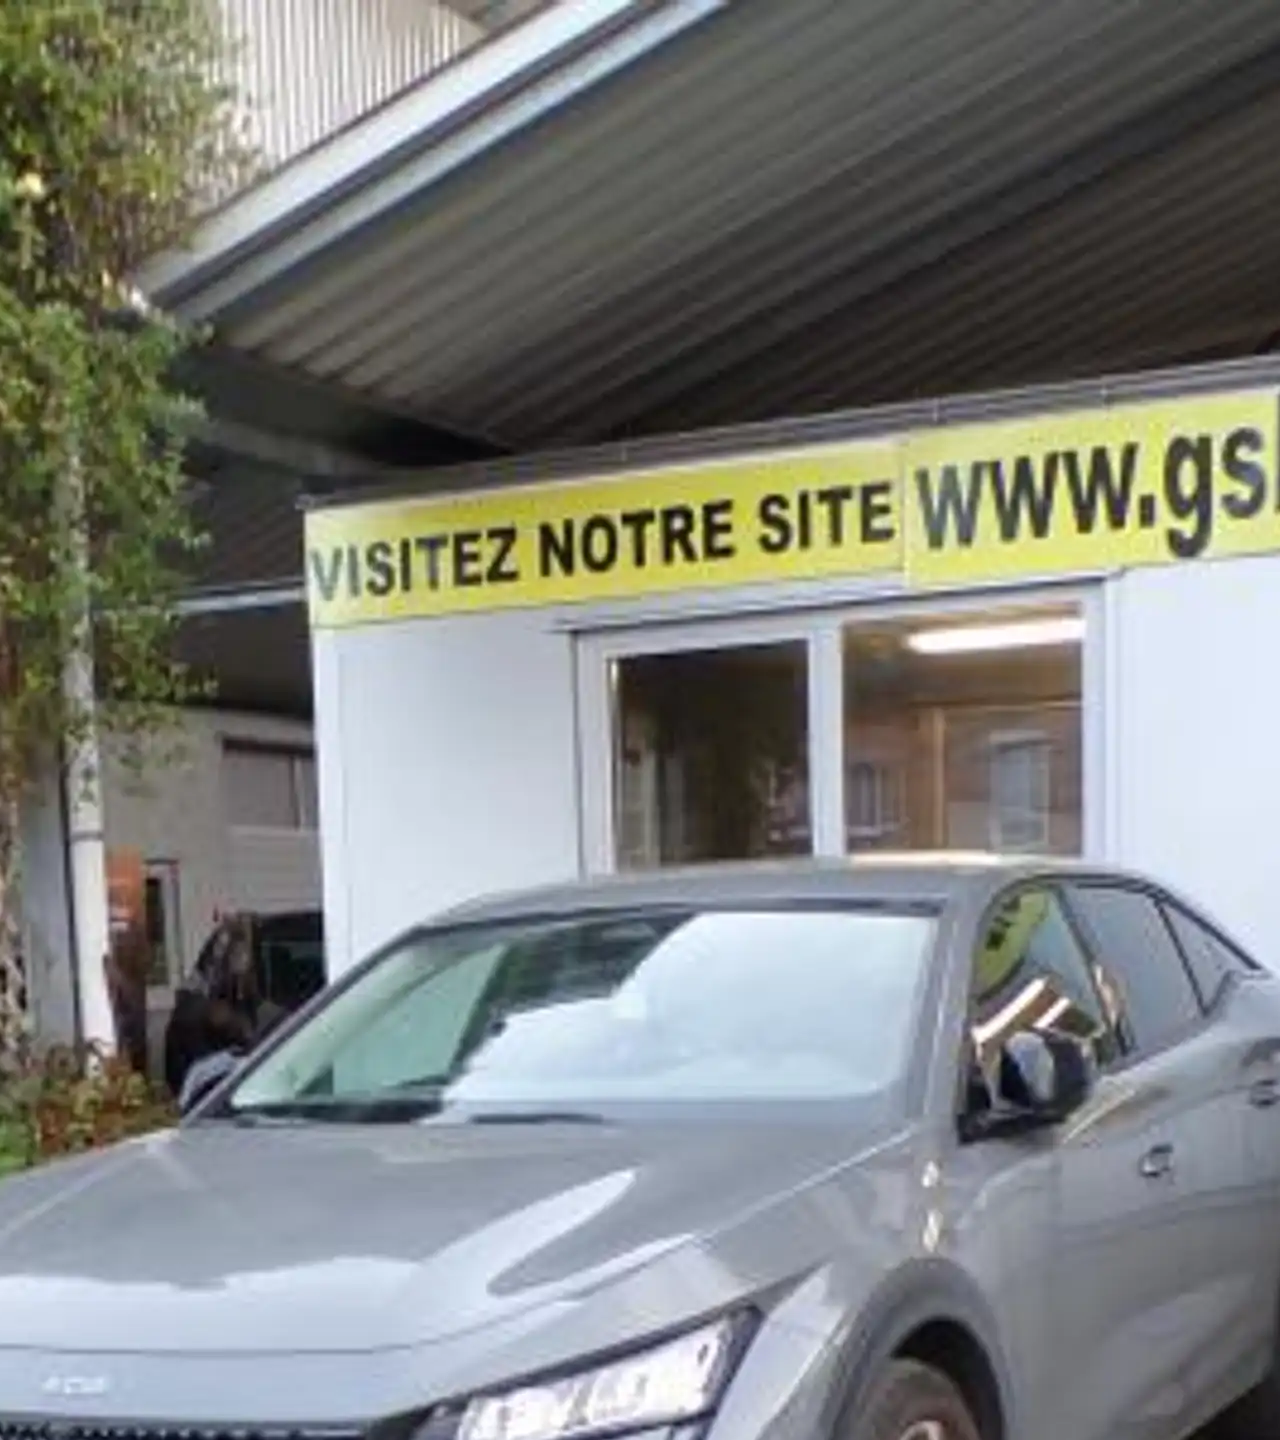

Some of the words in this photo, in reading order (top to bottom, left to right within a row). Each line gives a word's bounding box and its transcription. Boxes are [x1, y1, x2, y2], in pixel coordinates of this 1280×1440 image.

[310, 527, 519, 602] VISITEZ
[538, 498, 736, 578] NOTRE
[757, 480, 895, 553] SITE
